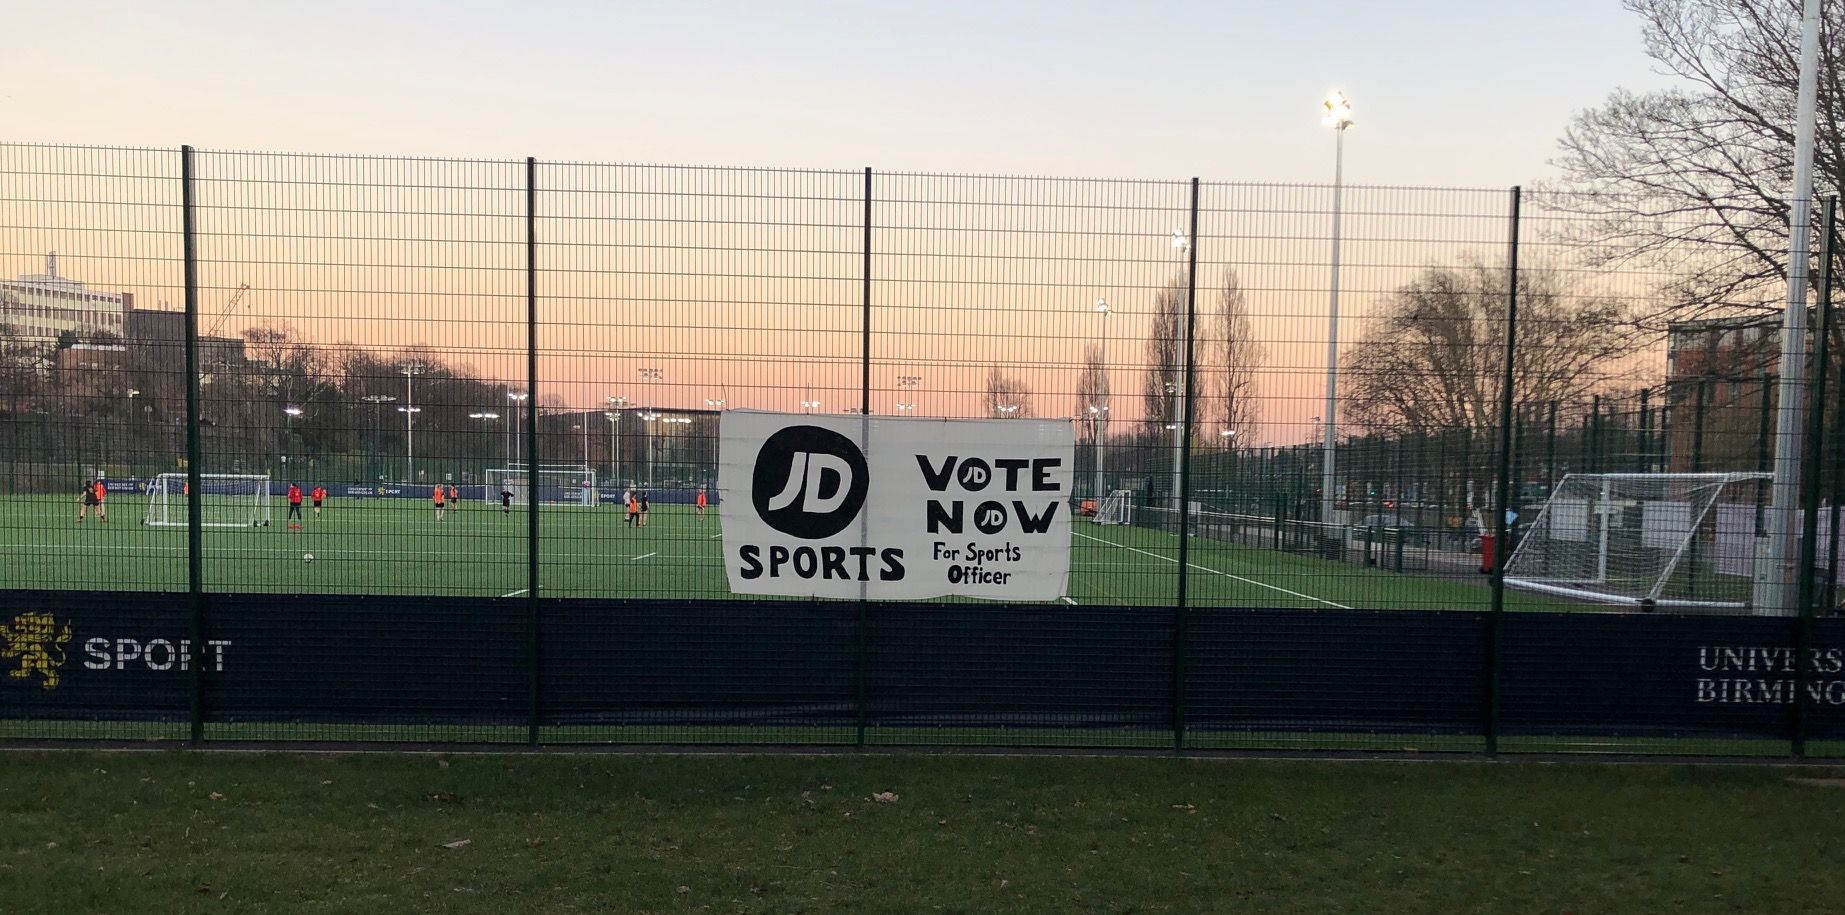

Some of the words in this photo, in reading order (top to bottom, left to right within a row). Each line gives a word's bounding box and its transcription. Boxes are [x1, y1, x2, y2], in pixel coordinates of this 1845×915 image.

[768, 451, 853, 514] JD
[916, 455, 1061, 491] VOTE
[963, 466, 987, 483] JD
[927, 500, 1059, 534] NOW
[981, 509, 1004, 526] JD
[739, 545, 906, 581] SPORTS
[933, 542, 960, 560] For
[965, 542, 1021, 565] Sports
[948, 565, 1011, 584] Officer
